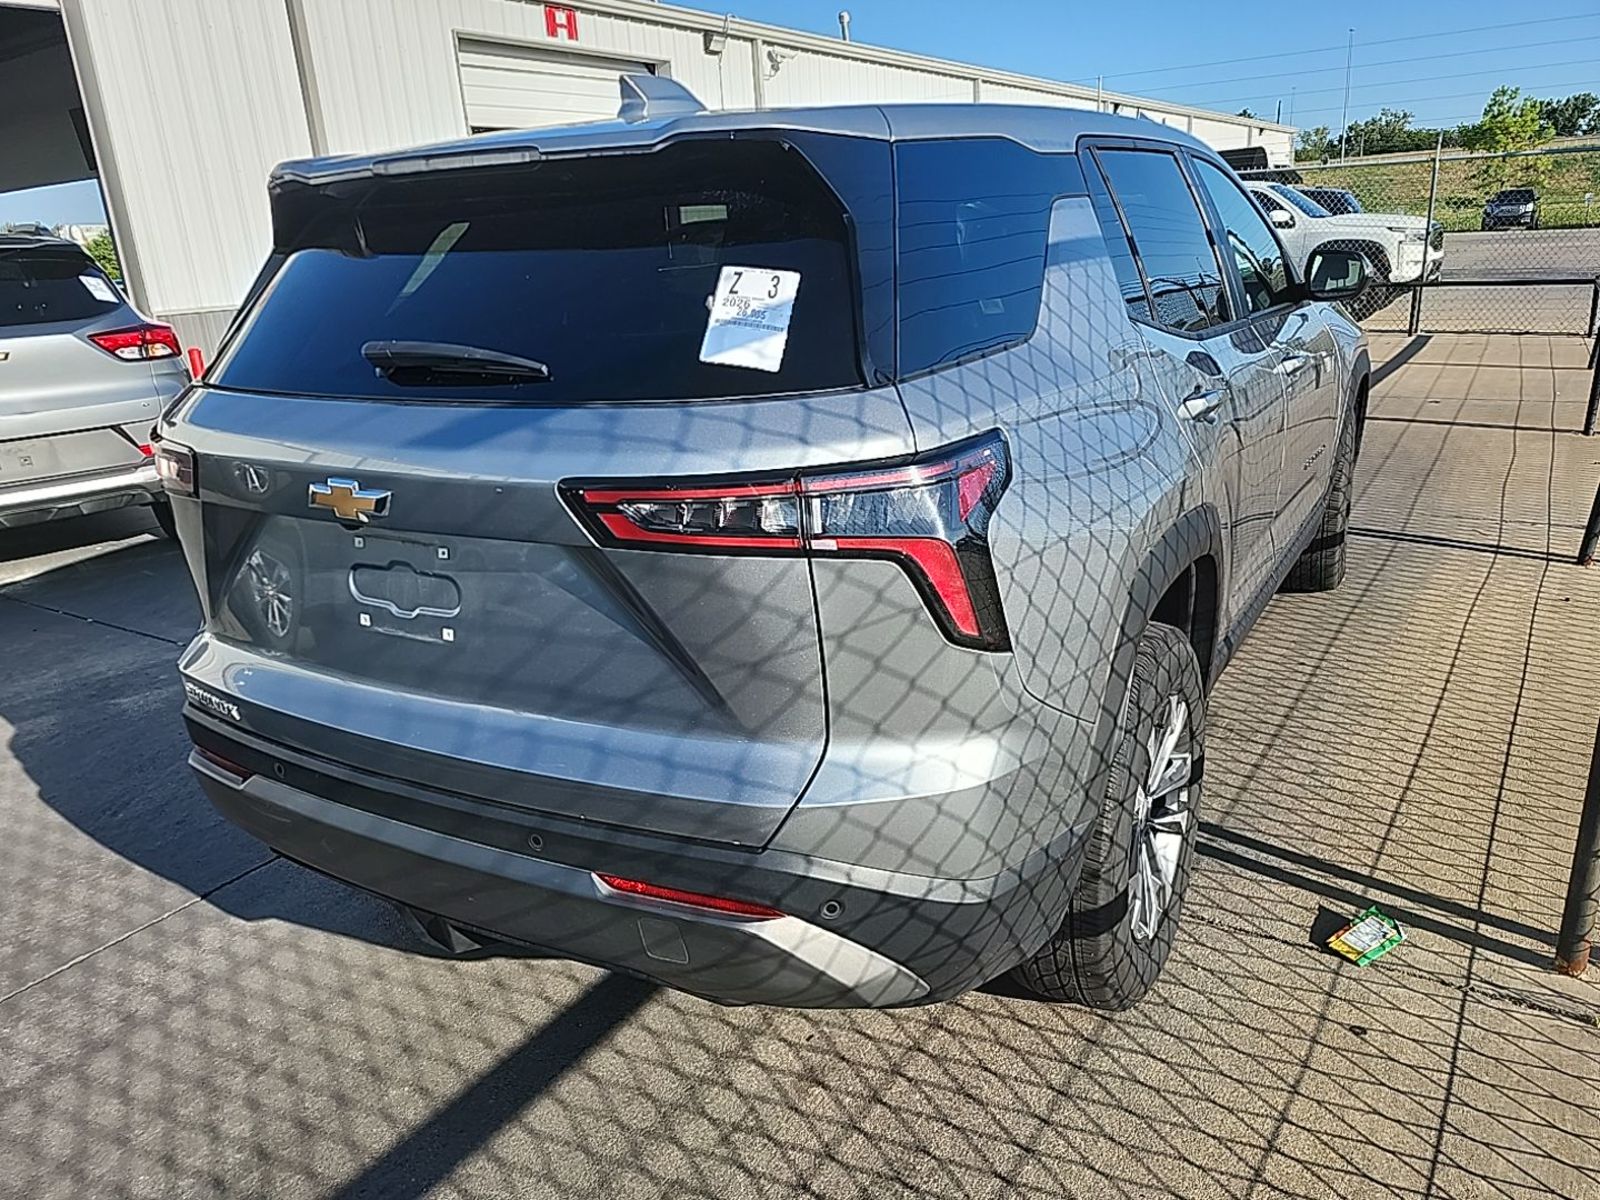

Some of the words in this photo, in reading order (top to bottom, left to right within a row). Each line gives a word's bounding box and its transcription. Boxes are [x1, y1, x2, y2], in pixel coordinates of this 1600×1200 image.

[545, 6, 579, 41] H
[729, 271, 743, 295] Z
[768, 275, 781, 299] 3
